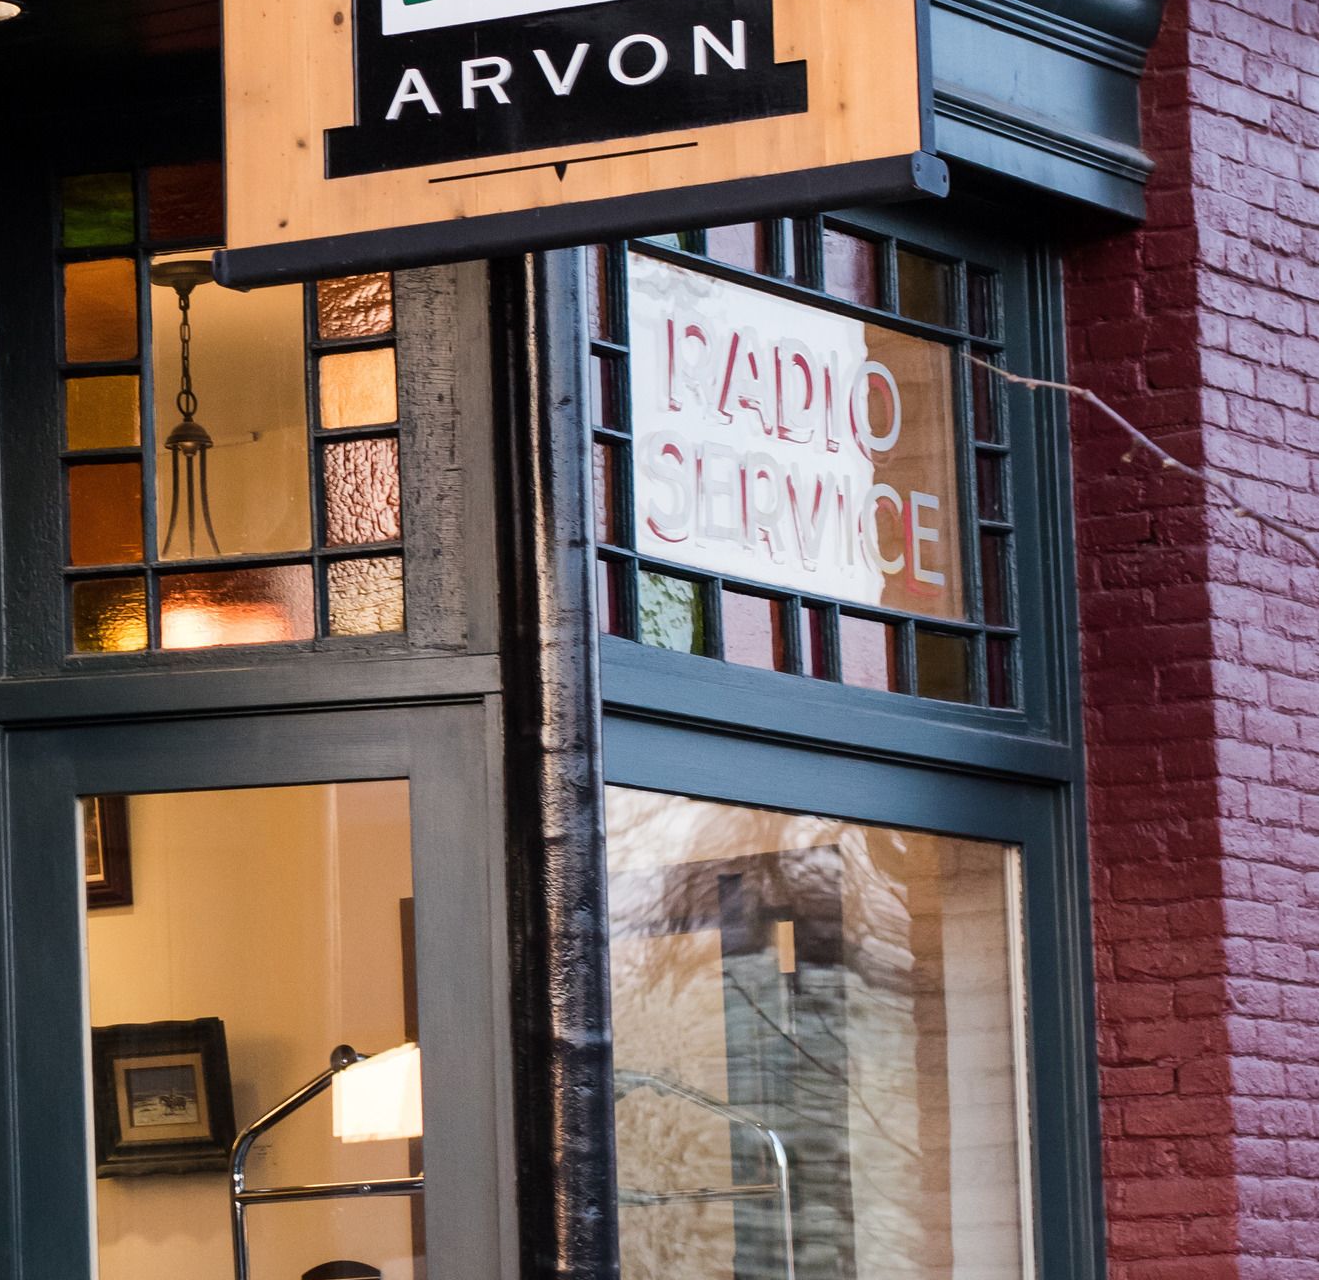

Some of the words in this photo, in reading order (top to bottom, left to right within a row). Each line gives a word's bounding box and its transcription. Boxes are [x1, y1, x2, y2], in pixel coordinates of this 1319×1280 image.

[385, 19, 749, 121] ARVON
[665, 312, 902, 460] RADIO
[645, 431, 946, 596] SERVICE
